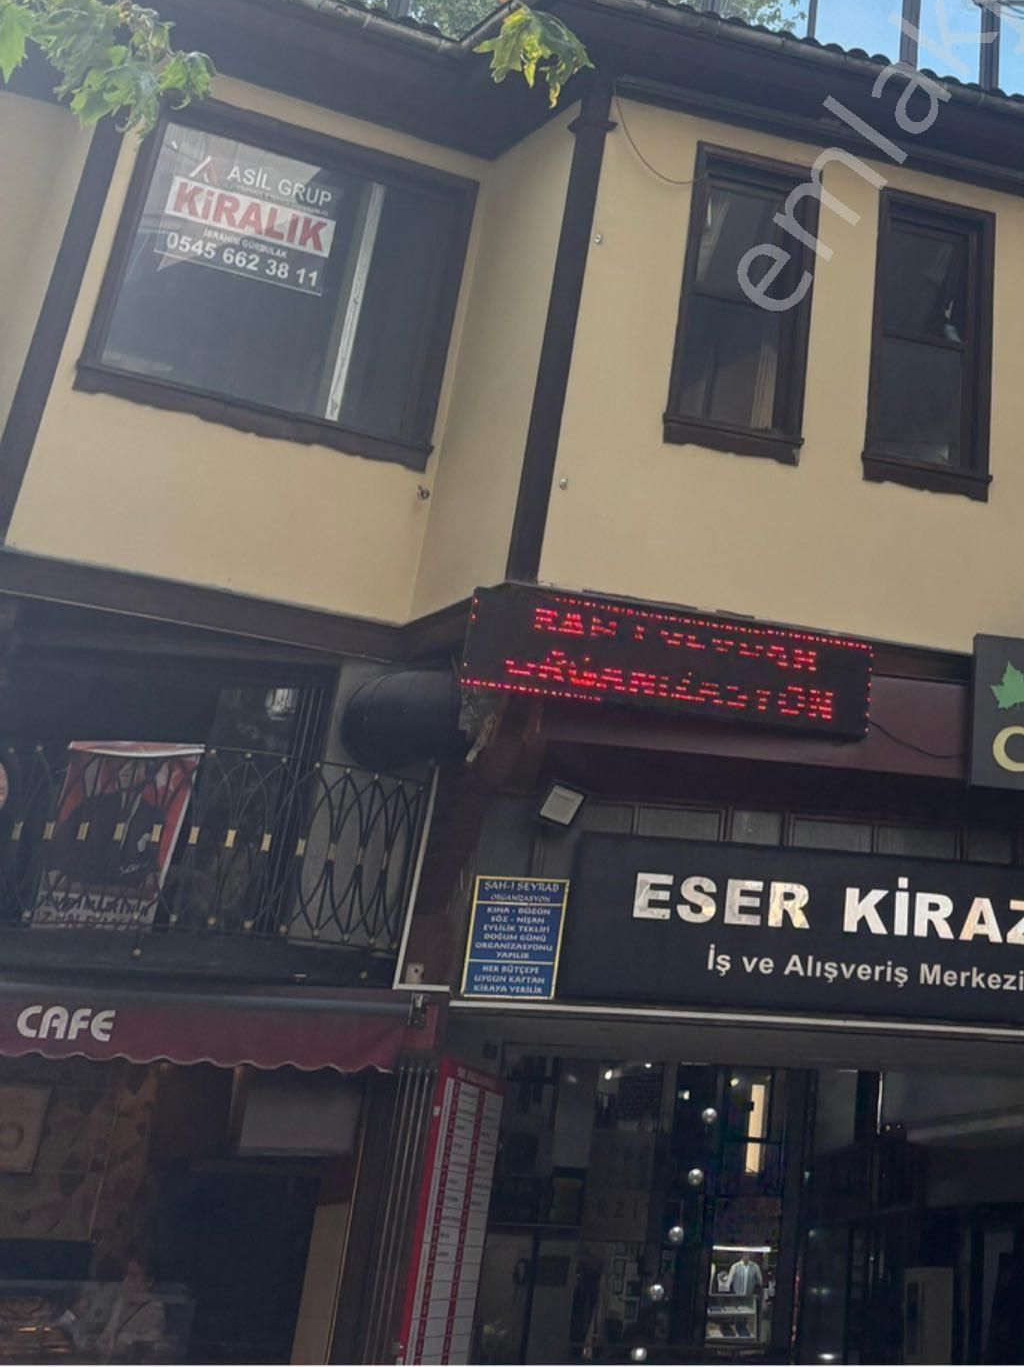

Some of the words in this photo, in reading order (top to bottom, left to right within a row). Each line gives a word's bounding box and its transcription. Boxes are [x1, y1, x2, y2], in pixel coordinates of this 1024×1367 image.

[227, 165, 272, 191] ASİL
[278, 179, 332, 206] GRUP
[166, 232, 217, 259] 0545
[223, 248, 260, 271] 662
[265, 259, 289, 279] 38
[296, 268, 318, 287] 11
[632, 871, 810, 930] ESER
[516, 916, 545, 925] NİŞAN
[474, 975, 507, 984] UYGUN
[508, 976, 545, 984] KAFTAN
[482, 965, 499, 973] HER
[501, 964, 540, 975] BÜTÇEYE
[707, 944, 732, 977] İş
[743, 955, 774, 975] ve
[784, 953, 909, 988] Alışveriş
[473, 984, 508, 993] KİRAYA
[510, 985, 543, 995] VERİLİR
[17, 1004, 116, 1042] CAFE
